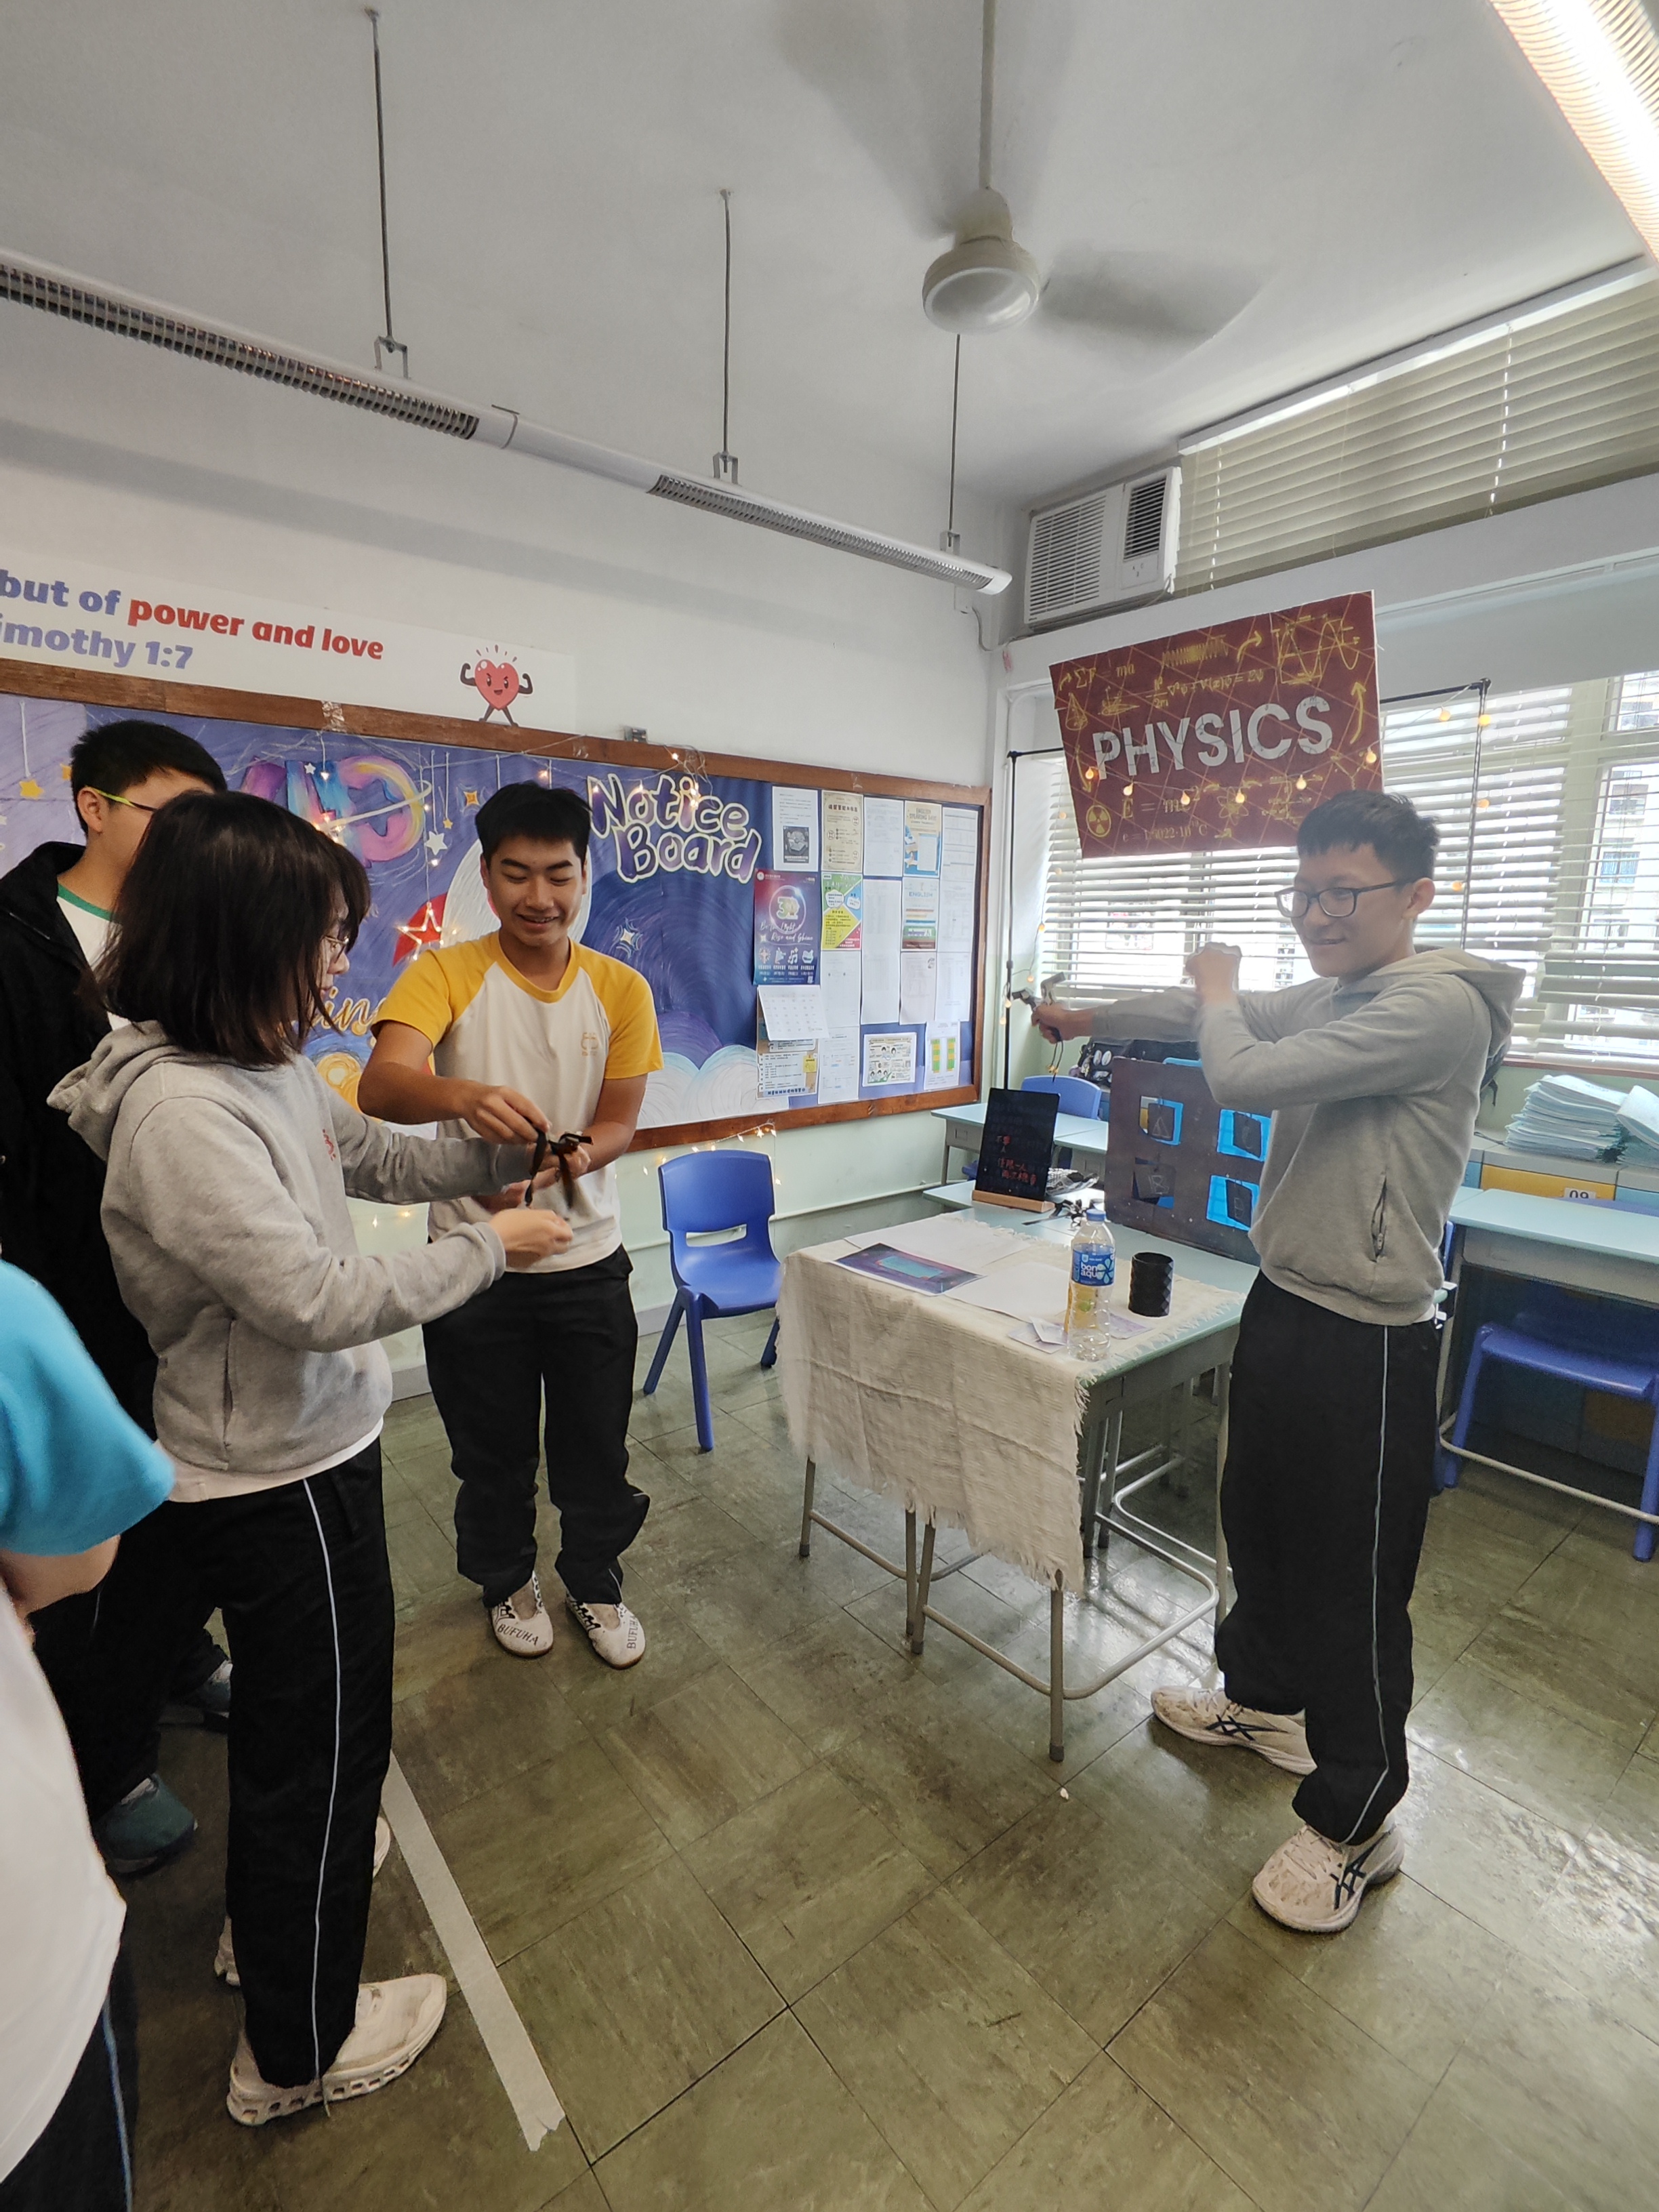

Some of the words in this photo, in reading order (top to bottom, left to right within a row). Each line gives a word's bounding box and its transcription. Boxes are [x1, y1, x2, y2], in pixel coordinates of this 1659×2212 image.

[0, 569, 69, 607] but
[79, 589, 121, 615] of
[127, 599, 245, 636] power
[251, 620, 315, 650] and
[321, 629, 384, 660] love
[145, 640, 194, 670] 1:7
[1092, 695, 1334, 781] PHYSICS
[588, 773, 749, 841] Notice
[613, 819, 762, 883] Board
[1081, 1261, 1097, 1271] bon
